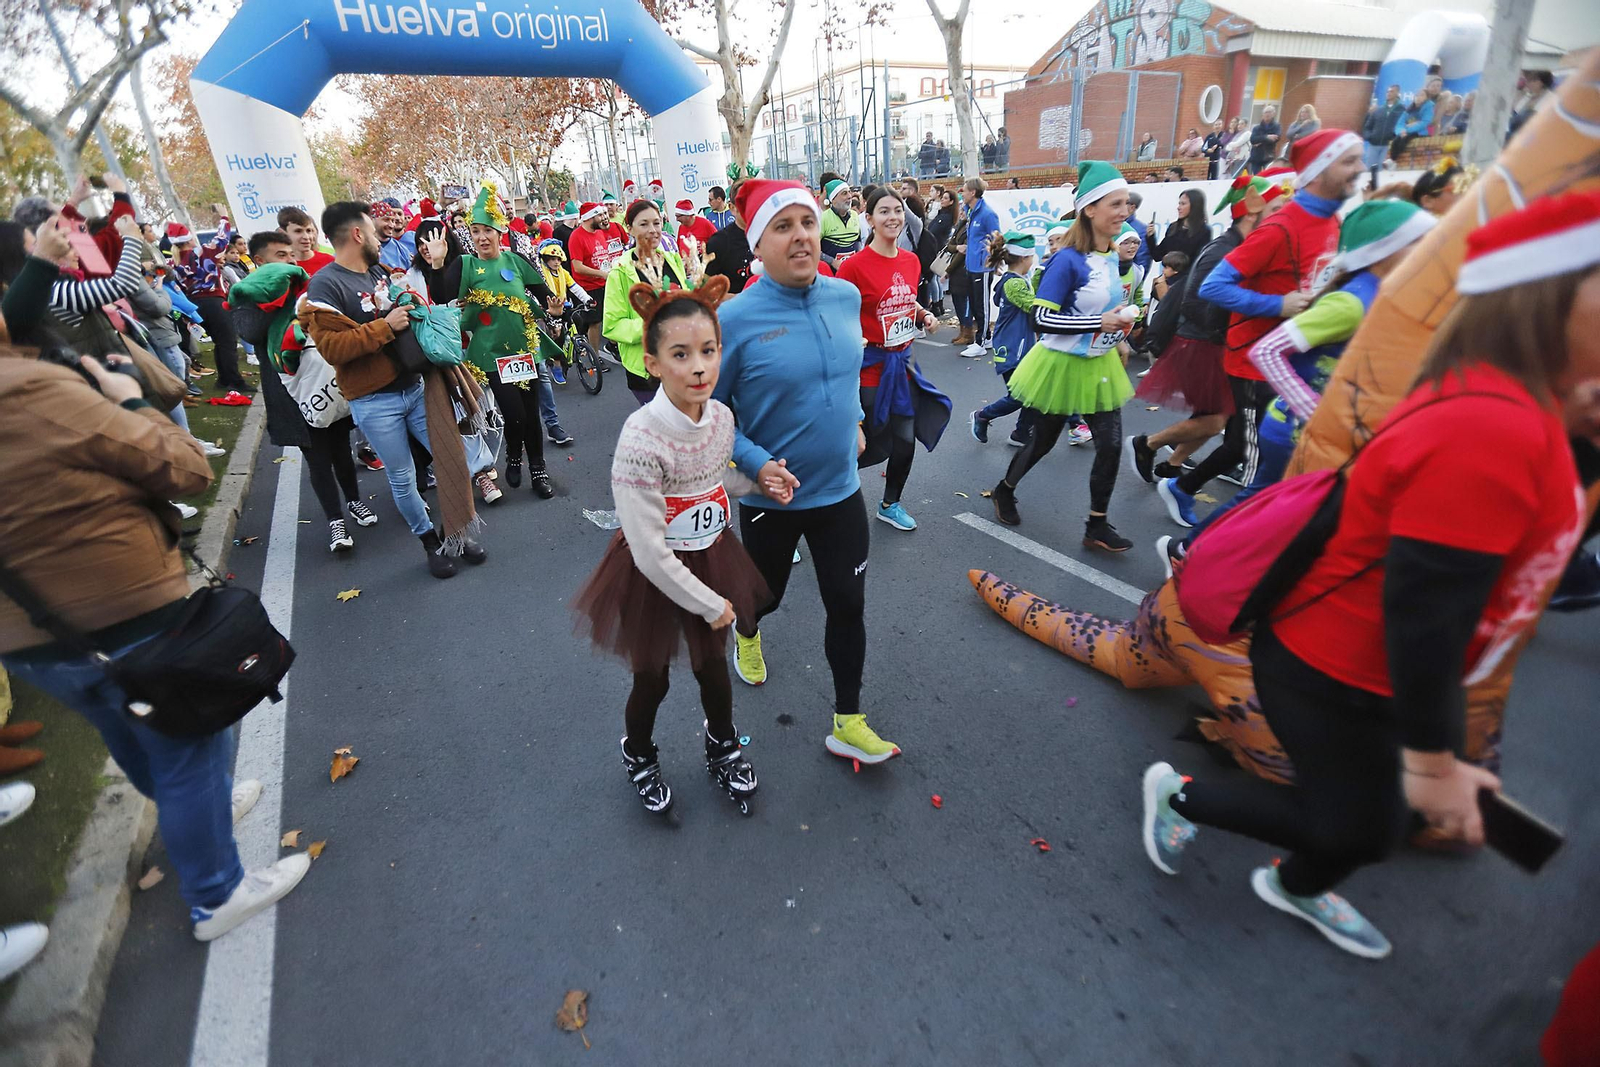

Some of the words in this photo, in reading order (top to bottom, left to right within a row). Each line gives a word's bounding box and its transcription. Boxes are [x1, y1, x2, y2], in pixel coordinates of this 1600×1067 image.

[334, 0, 480, 37] Huelva
[491, 4, 609, 49] original
[677, 139, 720, 156] Huelva
[226, 153, 295, 171] Huelva
[266, 204, 307, 214] HUA
[507, 362, 525, 374] 137
[691, 506, 713, 532] 19
